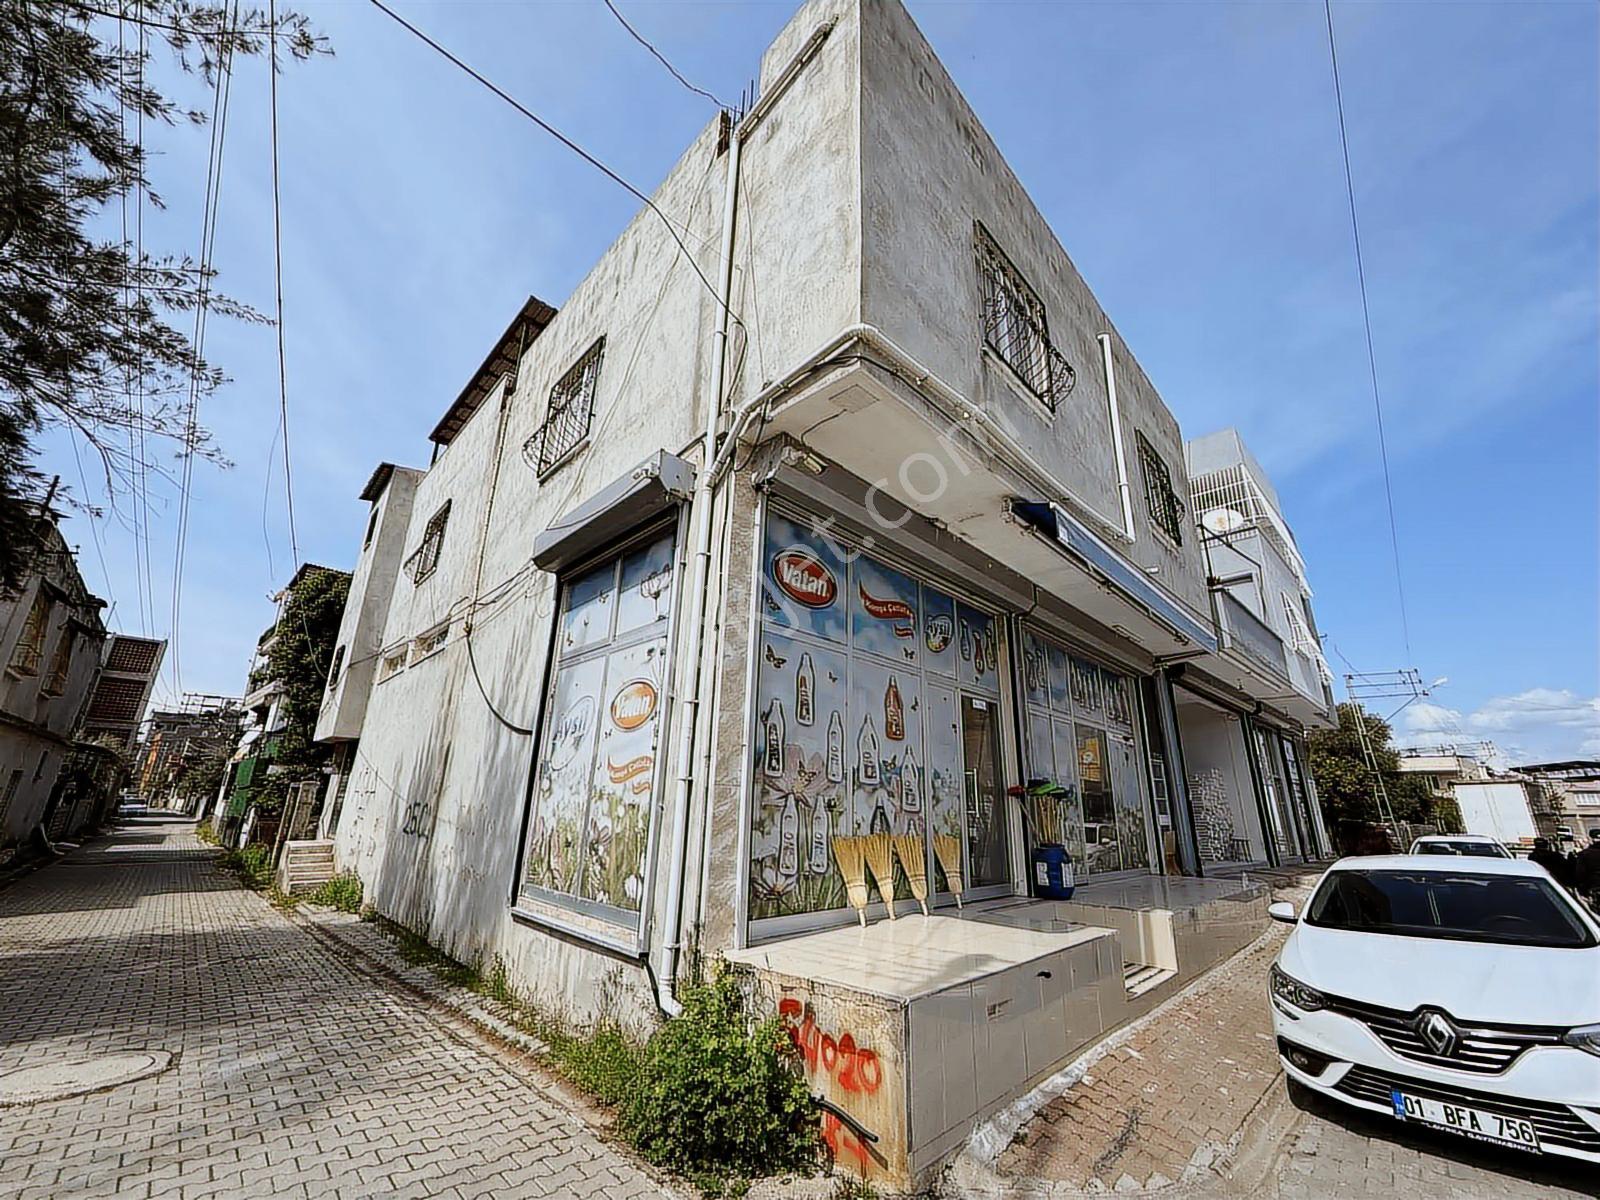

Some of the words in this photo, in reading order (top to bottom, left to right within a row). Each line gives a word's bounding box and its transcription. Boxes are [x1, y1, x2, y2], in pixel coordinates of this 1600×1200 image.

[783, 561, 828, 597] Vatan
[1403, 1096, 1424, 1117] 01
[1442, 1105, 1482, 1131] BFA
[1492, 1116, 1533, 1143] 756
